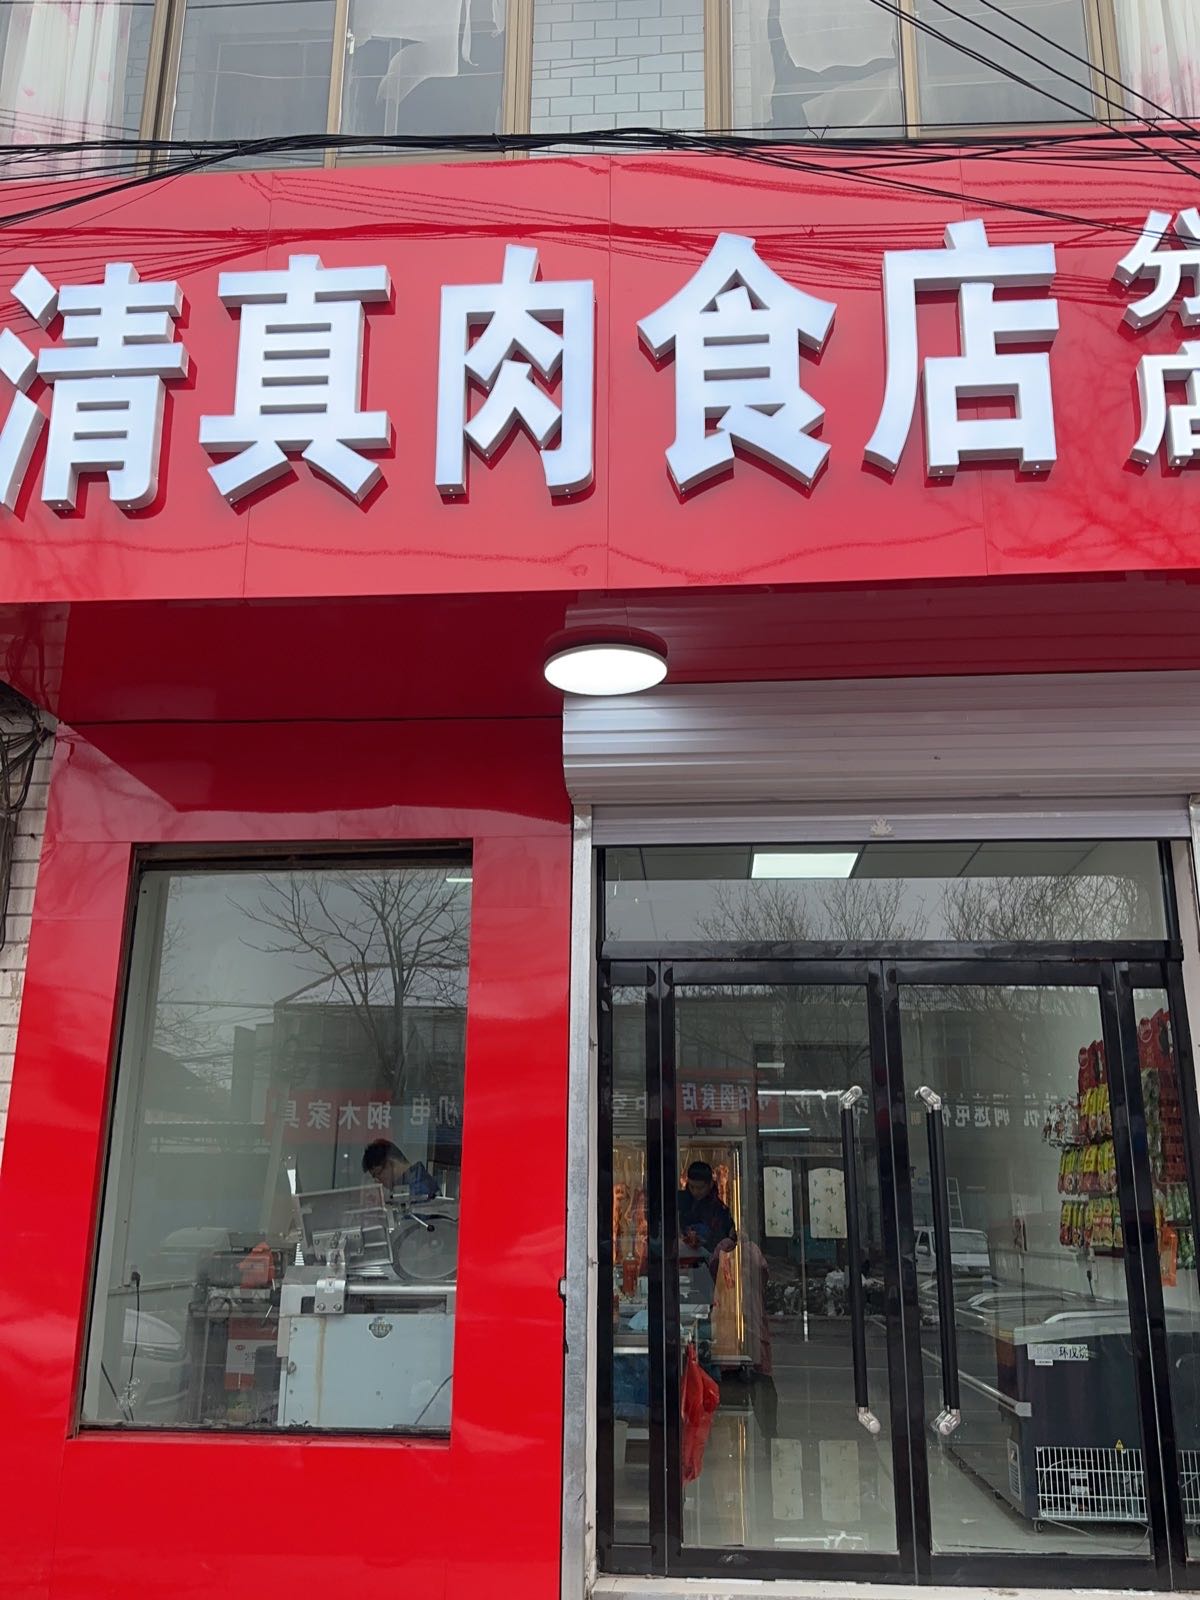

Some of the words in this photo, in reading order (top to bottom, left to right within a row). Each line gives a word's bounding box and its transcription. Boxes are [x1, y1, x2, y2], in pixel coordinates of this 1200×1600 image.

[0, 218, 1060, 512] 清真肉食店
